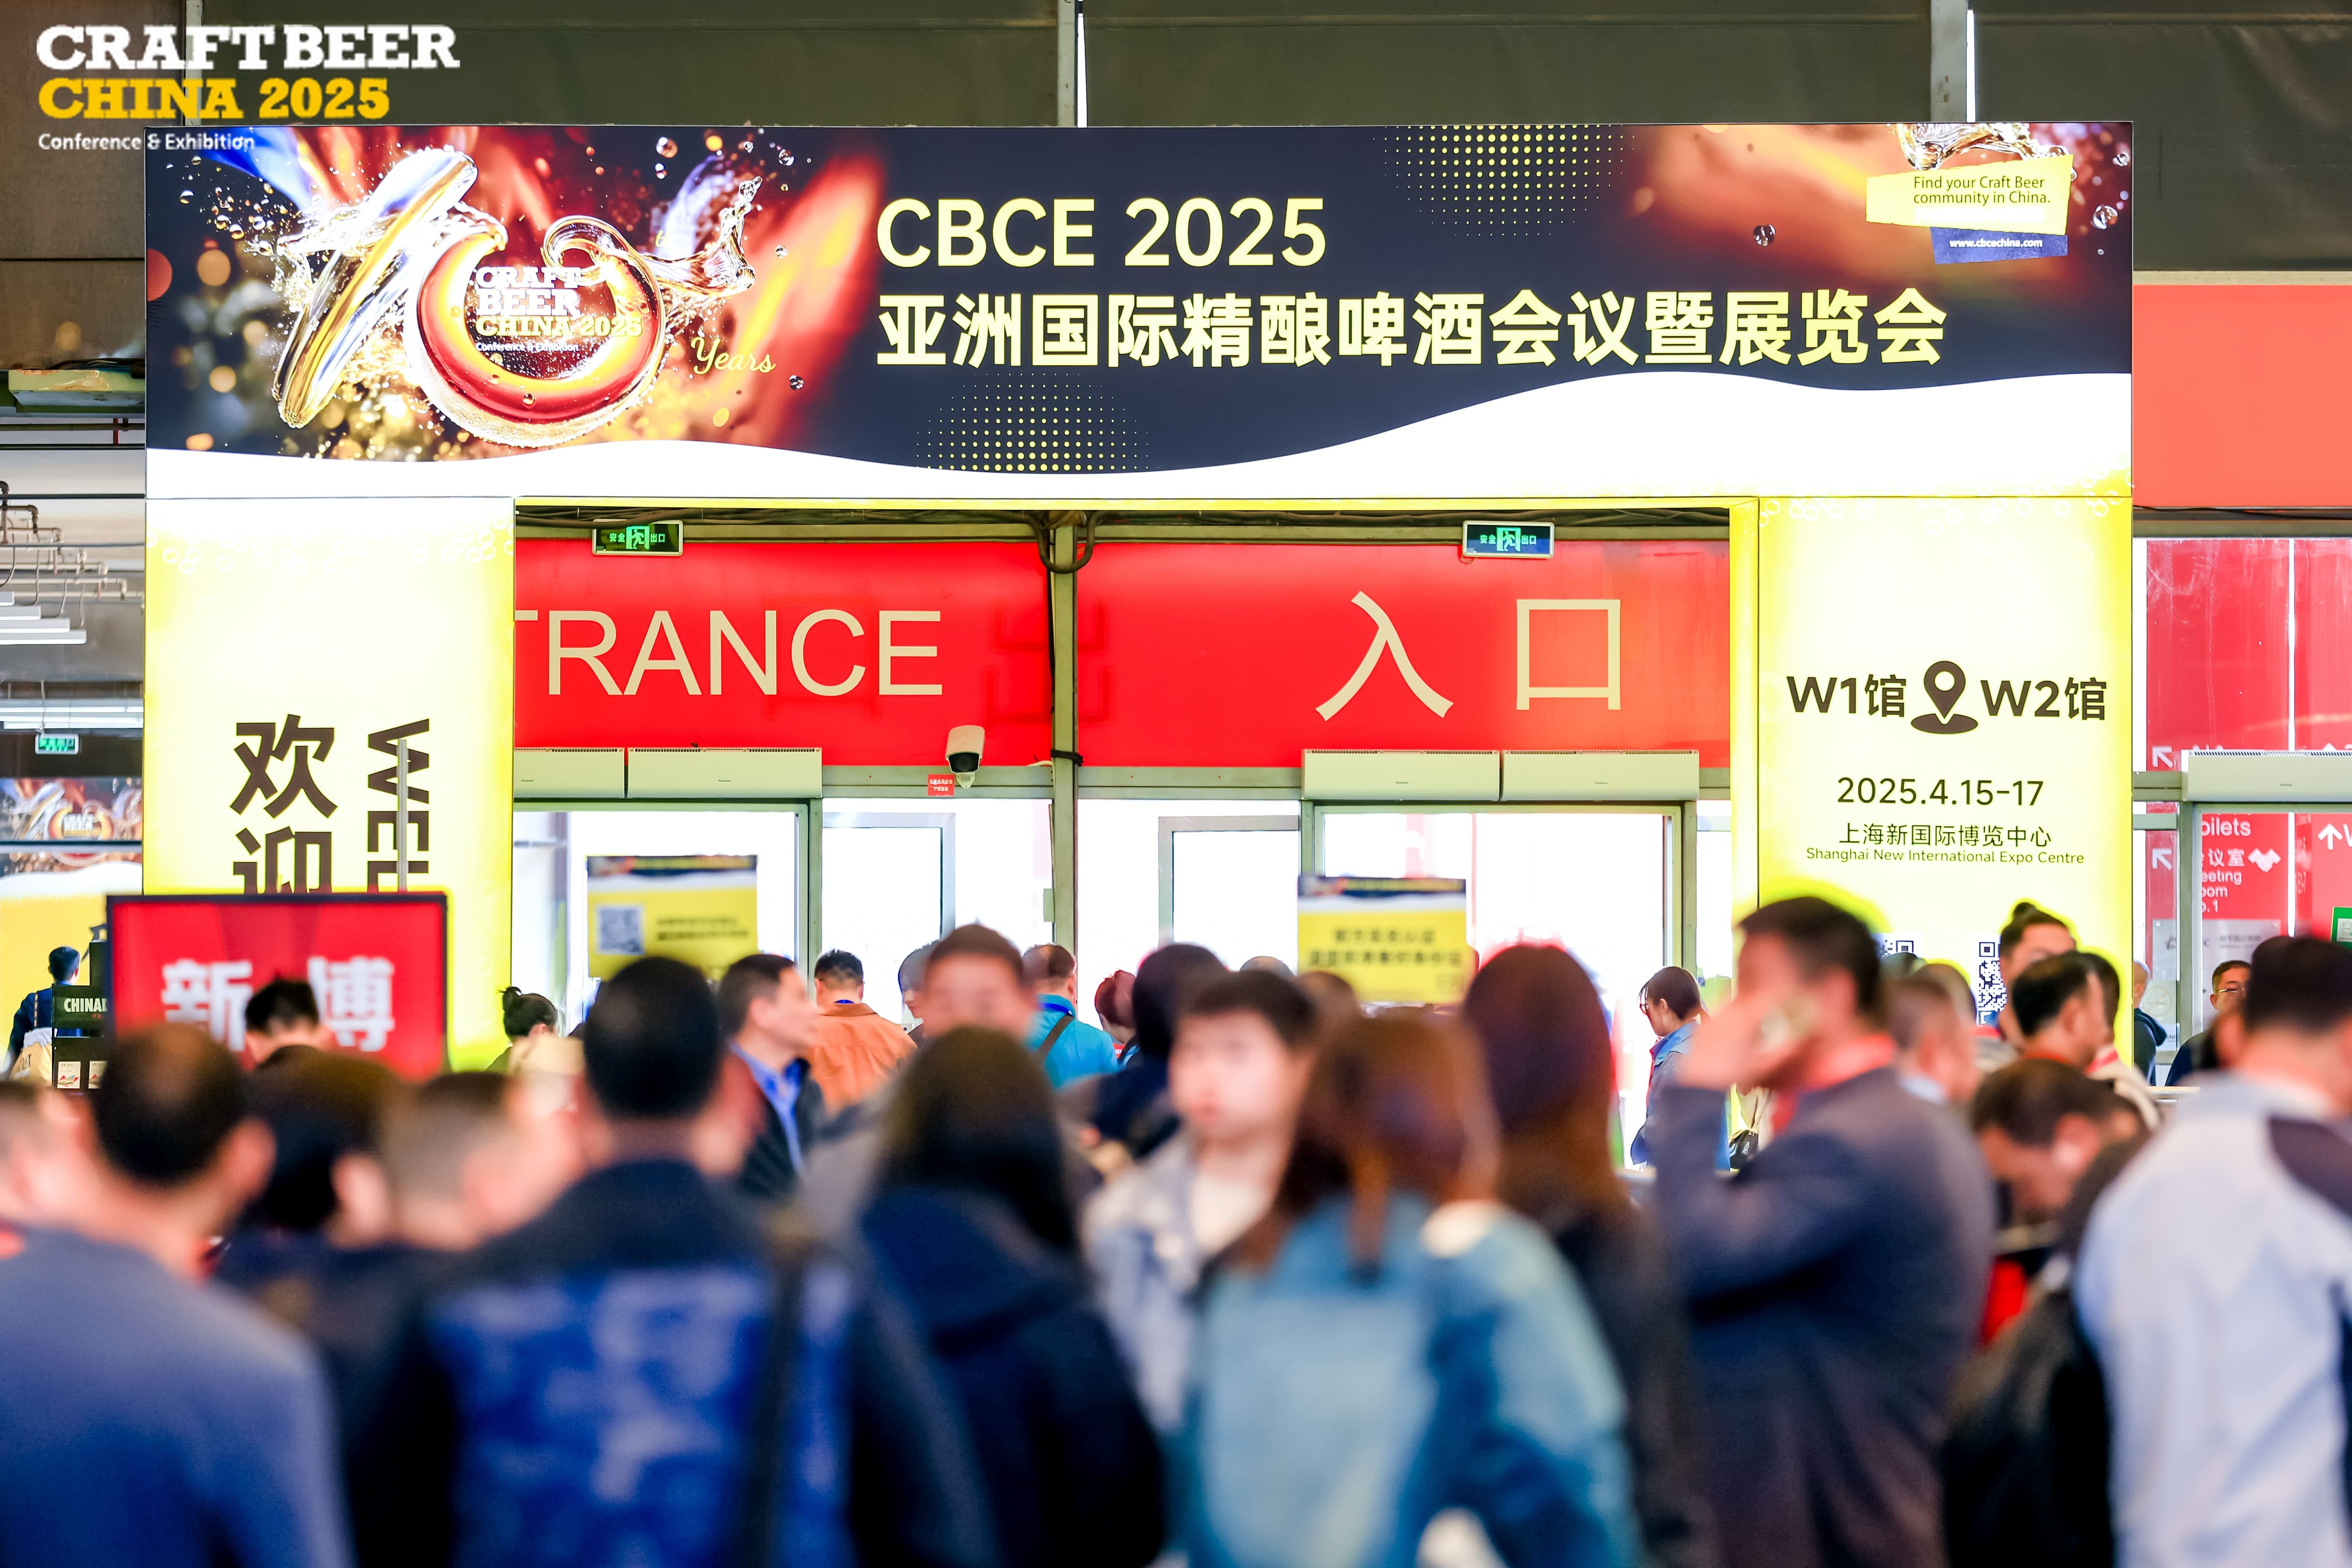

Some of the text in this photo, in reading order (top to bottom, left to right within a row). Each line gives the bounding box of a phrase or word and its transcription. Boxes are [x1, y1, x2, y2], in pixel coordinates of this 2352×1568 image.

[1913, 175, 2044, 193] Find your Craft Beer
[1913, 191, 2051, 207] community in China.
[876, 197, 1327, 268] CBCE 2025
[1949, 238, 2043, 248] www.cbcechina.com
[475, 266, 582, 289] CRAFT
[476, 289, 582, 316] BEER
[475, 316, 643, 337] CHINA 2025
[876, 288, 1948, 368] 亚洲国际精酿啤酒会议暨展览会
[476, 342, 525, 351] Conference
[690, 337, 776, 375] Years
[1315, 590, 1621, 722] 入口
[1786, 674, 2107, 721] W1馆 W2馆
[229, 714, 338, 893] 欢迎
[1837, 777, 2044, 806] 2025.4.15-17
[1838, 822, 2052, 847] 上海新国际博览中心
[1806, 847, 2084, 865] Shanghai New International Expo Centre
[2202, 848, 2245, 867] 议室
